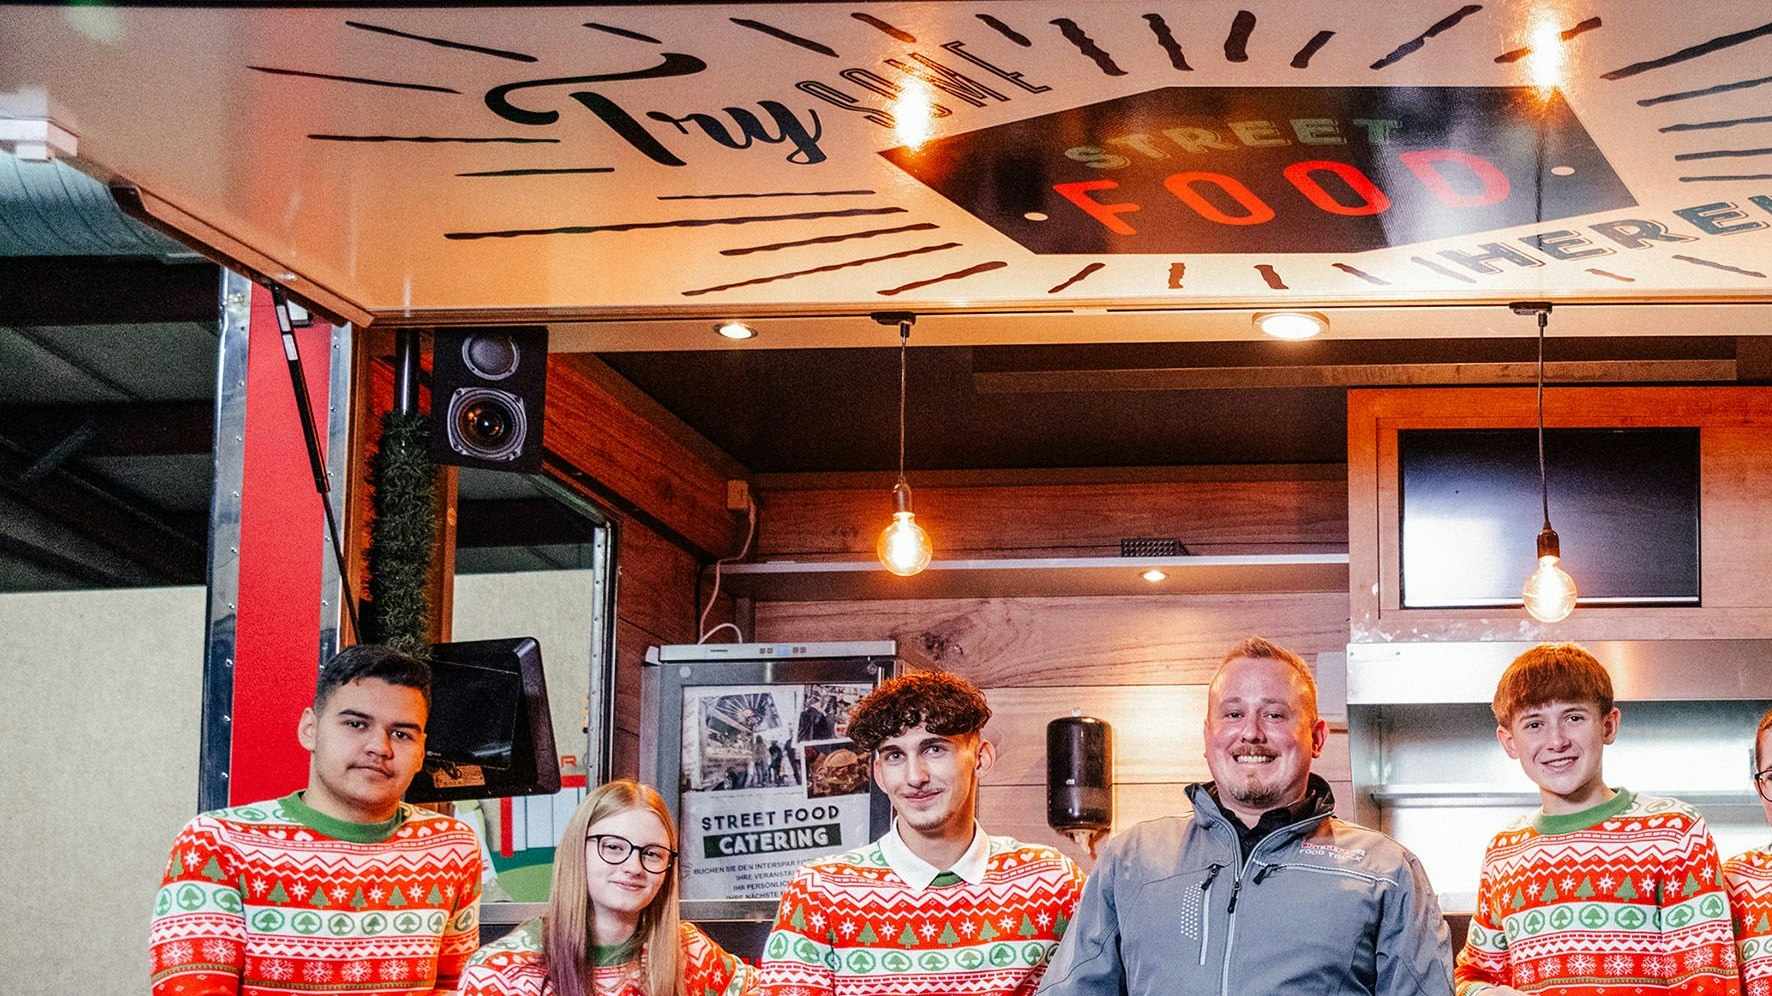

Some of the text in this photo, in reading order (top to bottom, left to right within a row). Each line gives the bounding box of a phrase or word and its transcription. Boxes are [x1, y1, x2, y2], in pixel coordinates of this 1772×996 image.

[485, 52, 827, 166] Try
[1064, 117, 1402, 171] STREET
[1052, 149, 1512, 236] FOOD
[702, 805, 839, 831] STREET FOOD
[719, 827, 829, 855] CATERING
[755, 860, 796, 870] INTERSPAR
